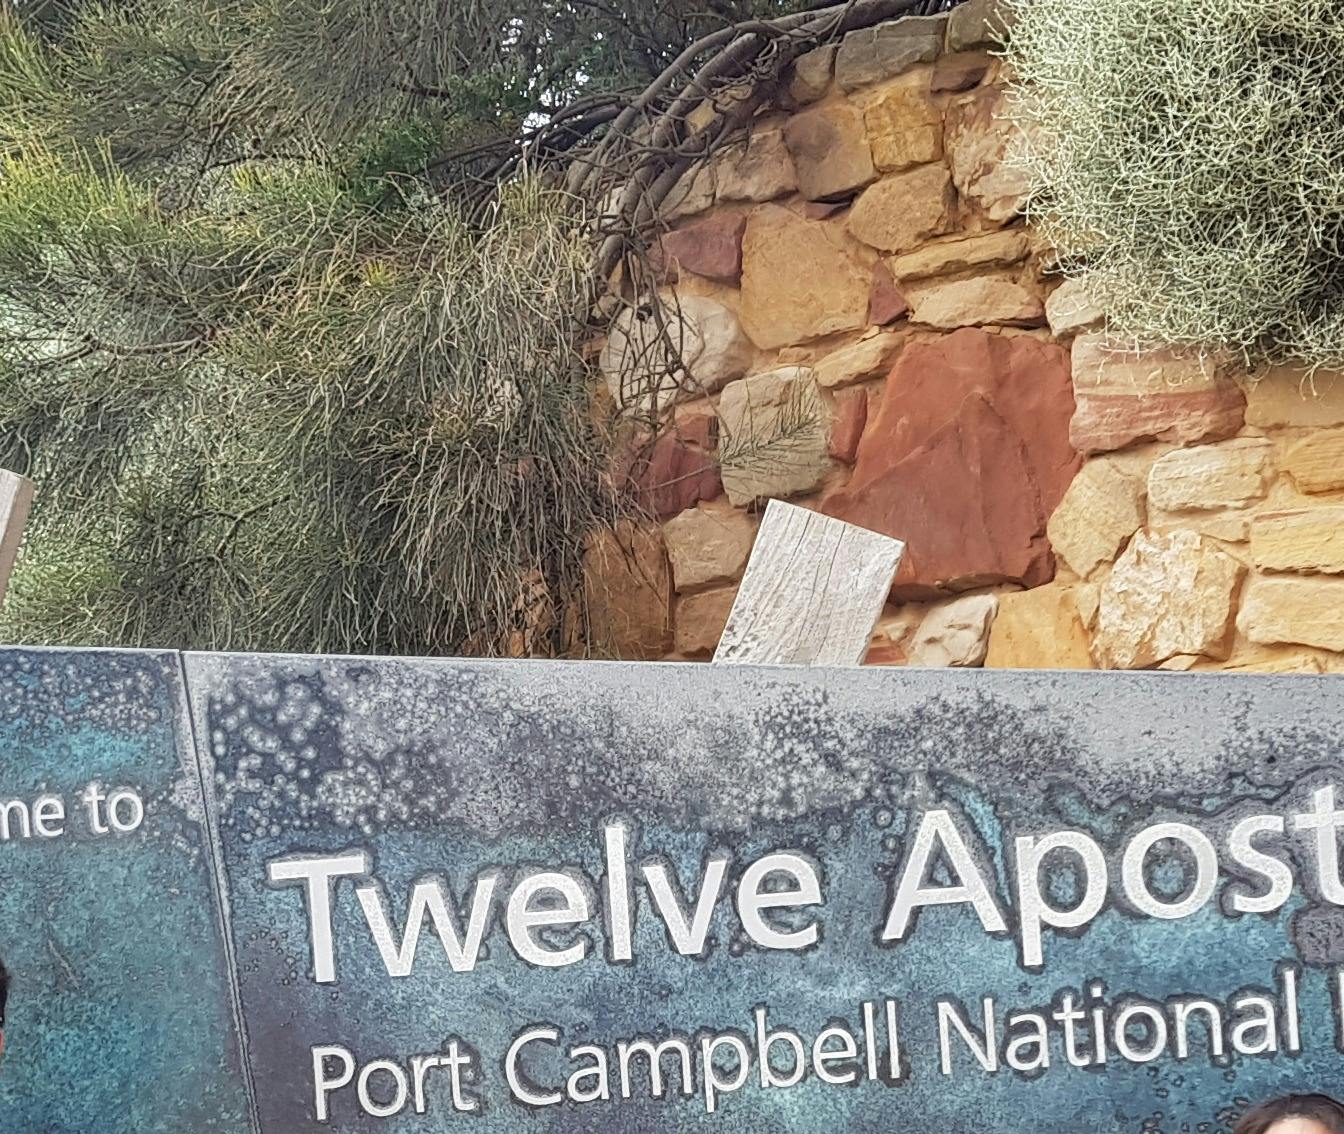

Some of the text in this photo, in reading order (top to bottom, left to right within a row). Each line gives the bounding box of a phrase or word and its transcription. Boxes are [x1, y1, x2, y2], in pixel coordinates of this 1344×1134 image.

[87, 788, 145, 834] to
[267, 826, 823, 984] Twelve
[312, 1040, 478, 1121] Port
[505, 1000, 901, 1112] Campbell
[936, 969, 1300, 1076] National
